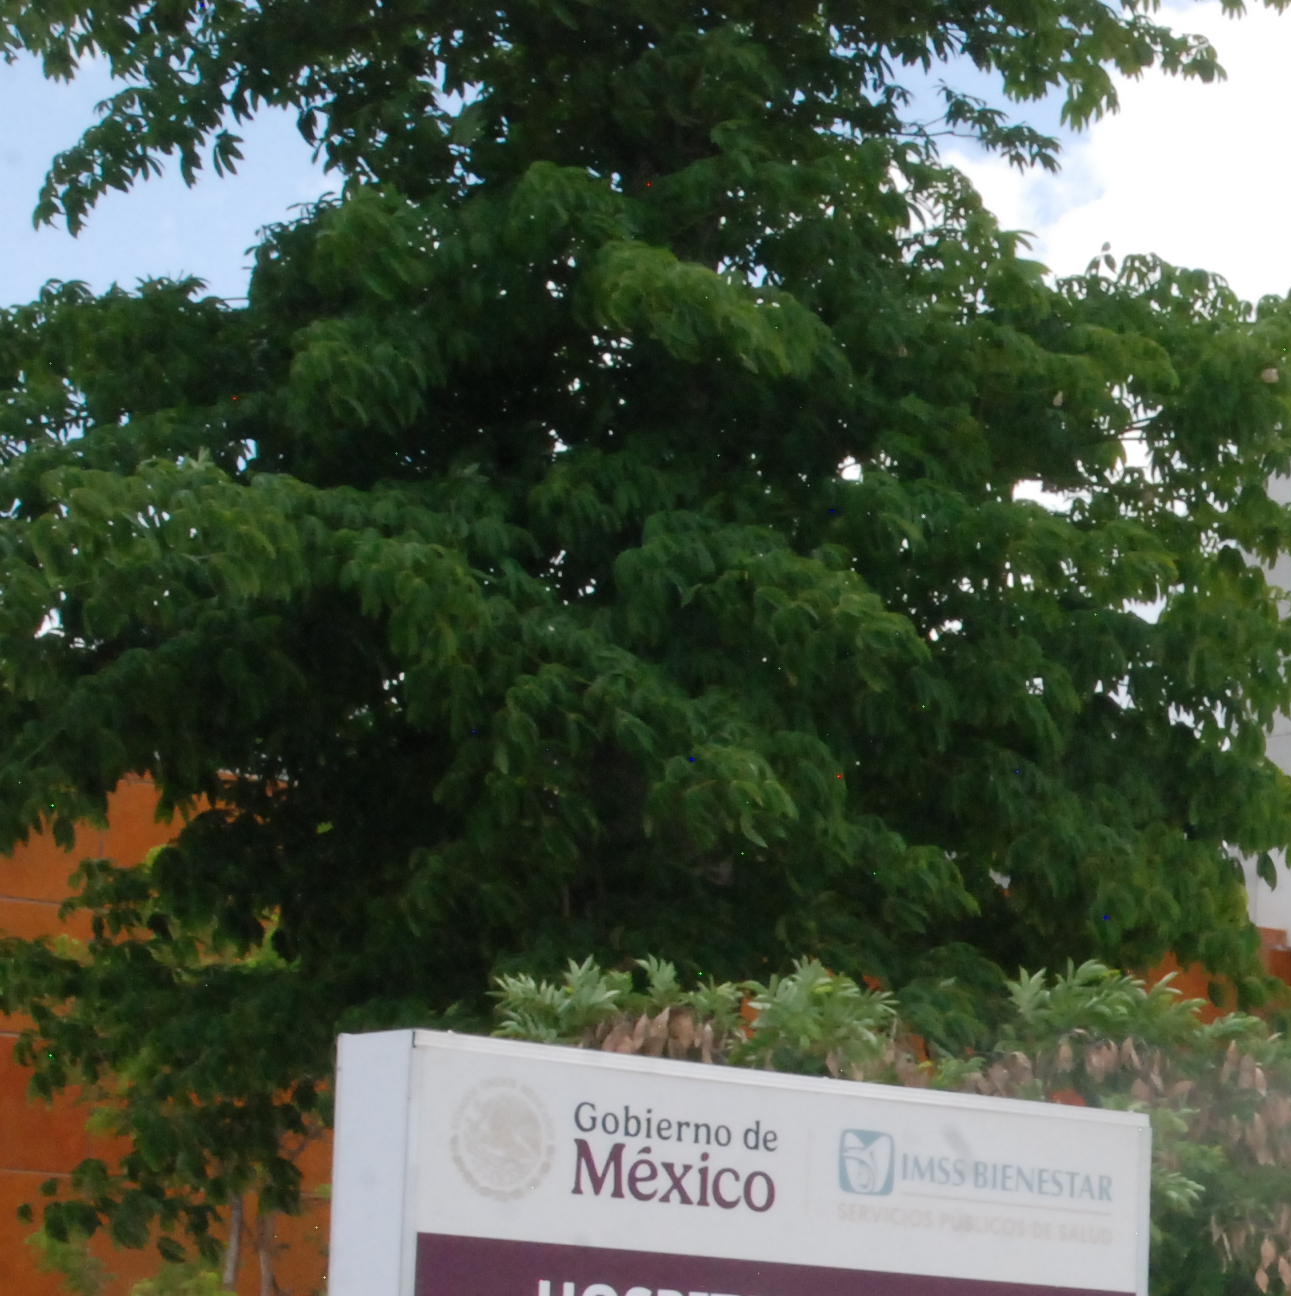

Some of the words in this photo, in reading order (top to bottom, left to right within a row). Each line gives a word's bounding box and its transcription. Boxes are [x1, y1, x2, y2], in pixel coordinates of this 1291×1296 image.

[574, 1102, 731, 1146] Gobierno
[742, 1121, 779, 1151] de
[572, 1139, 776, 1212] México
[902, 1153, 965, 1186] IMSS
[972, 1160, 1113, 1201] BIENESTAR
